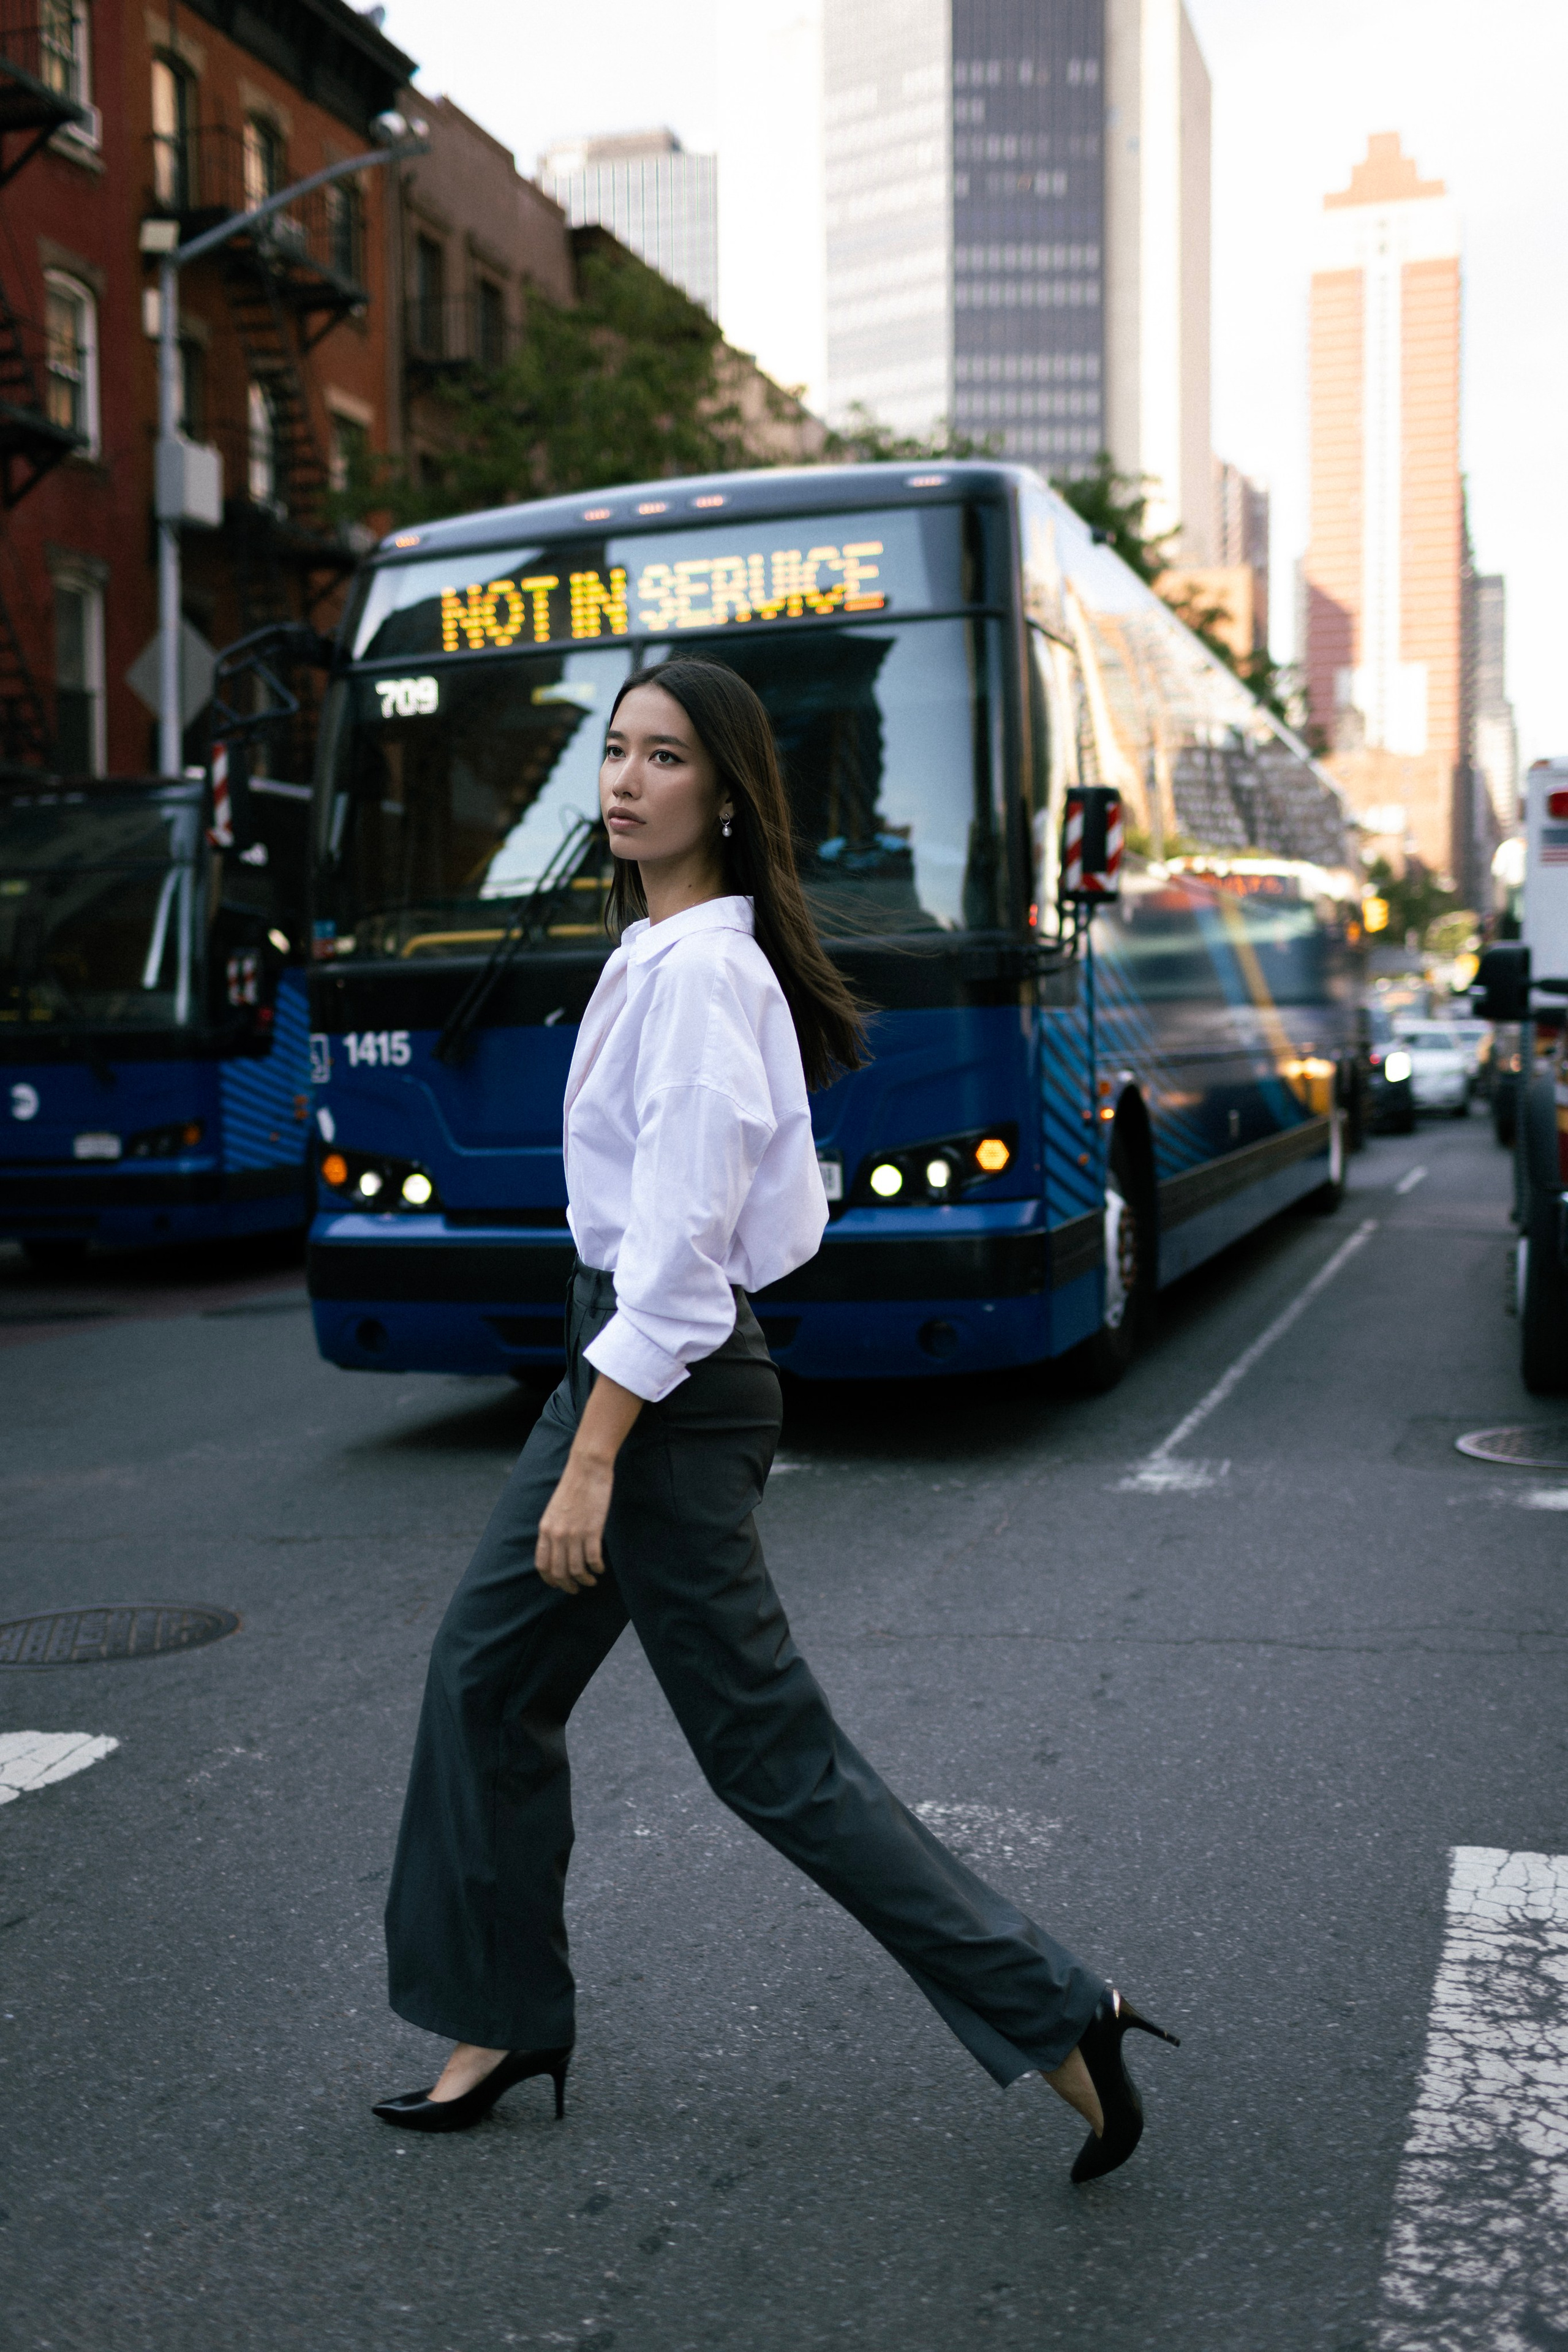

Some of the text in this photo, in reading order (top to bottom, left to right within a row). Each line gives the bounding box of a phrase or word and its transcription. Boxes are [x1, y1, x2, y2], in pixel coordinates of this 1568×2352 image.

[441, 541, 884, 652] NOT IN SERVICE
[375, 676, 439, 718] 709
[342, 1030, 412, 1067] 1415
